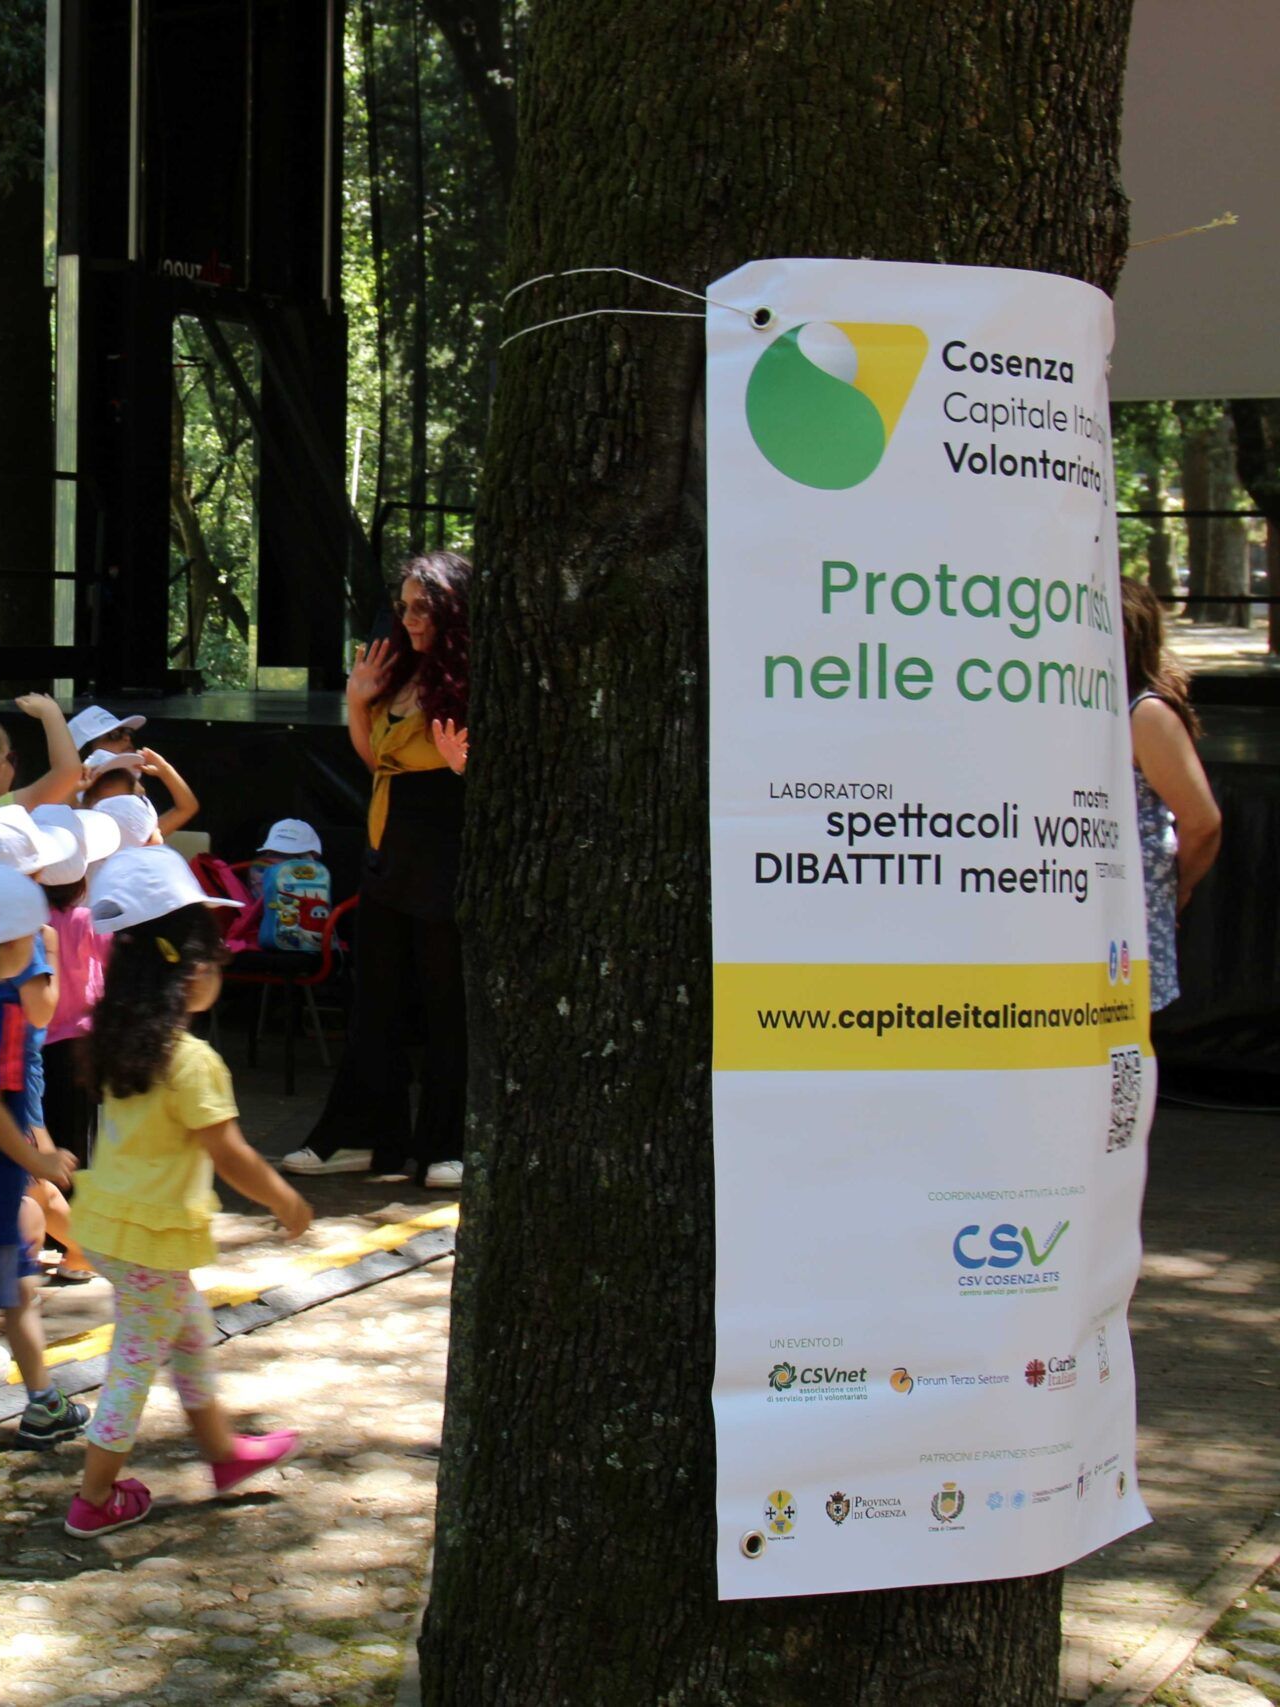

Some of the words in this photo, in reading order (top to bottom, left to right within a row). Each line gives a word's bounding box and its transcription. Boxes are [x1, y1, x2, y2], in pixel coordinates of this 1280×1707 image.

[942, 340, 1074, 384] Cosenza
[943, 391, 1067, 432] Capitale
[943, 442, 1101, 493] Volontariato
[764, 642, 934, 700] nelle
[769, 782, 893, 800] LABORATORI
[826, 802, 1018, 847] spettacoli
[755, 852, 941, 885] DIBATTITI
[960, 858, 1088, 904] meeting
[952, 1219, 1070, 1269] CSV
[958, 1275, 982, 1287] CSV
[984, 1273, 1040, 1286] COSENZA
[1042, 1271, 1060, 1283] ETS
[769, 1338, 785, 1350] UN
[787, 1337, 831, 1349] EVENTO
[832, 1337, 844, 1348] DI
[800, 1367, 868, 1385] CSVnet
[917, 1375, 948, 1386] Forum
[949, 1374, 976, 1385] Terzo
[978, 1374, 1010, 1385] Settore
